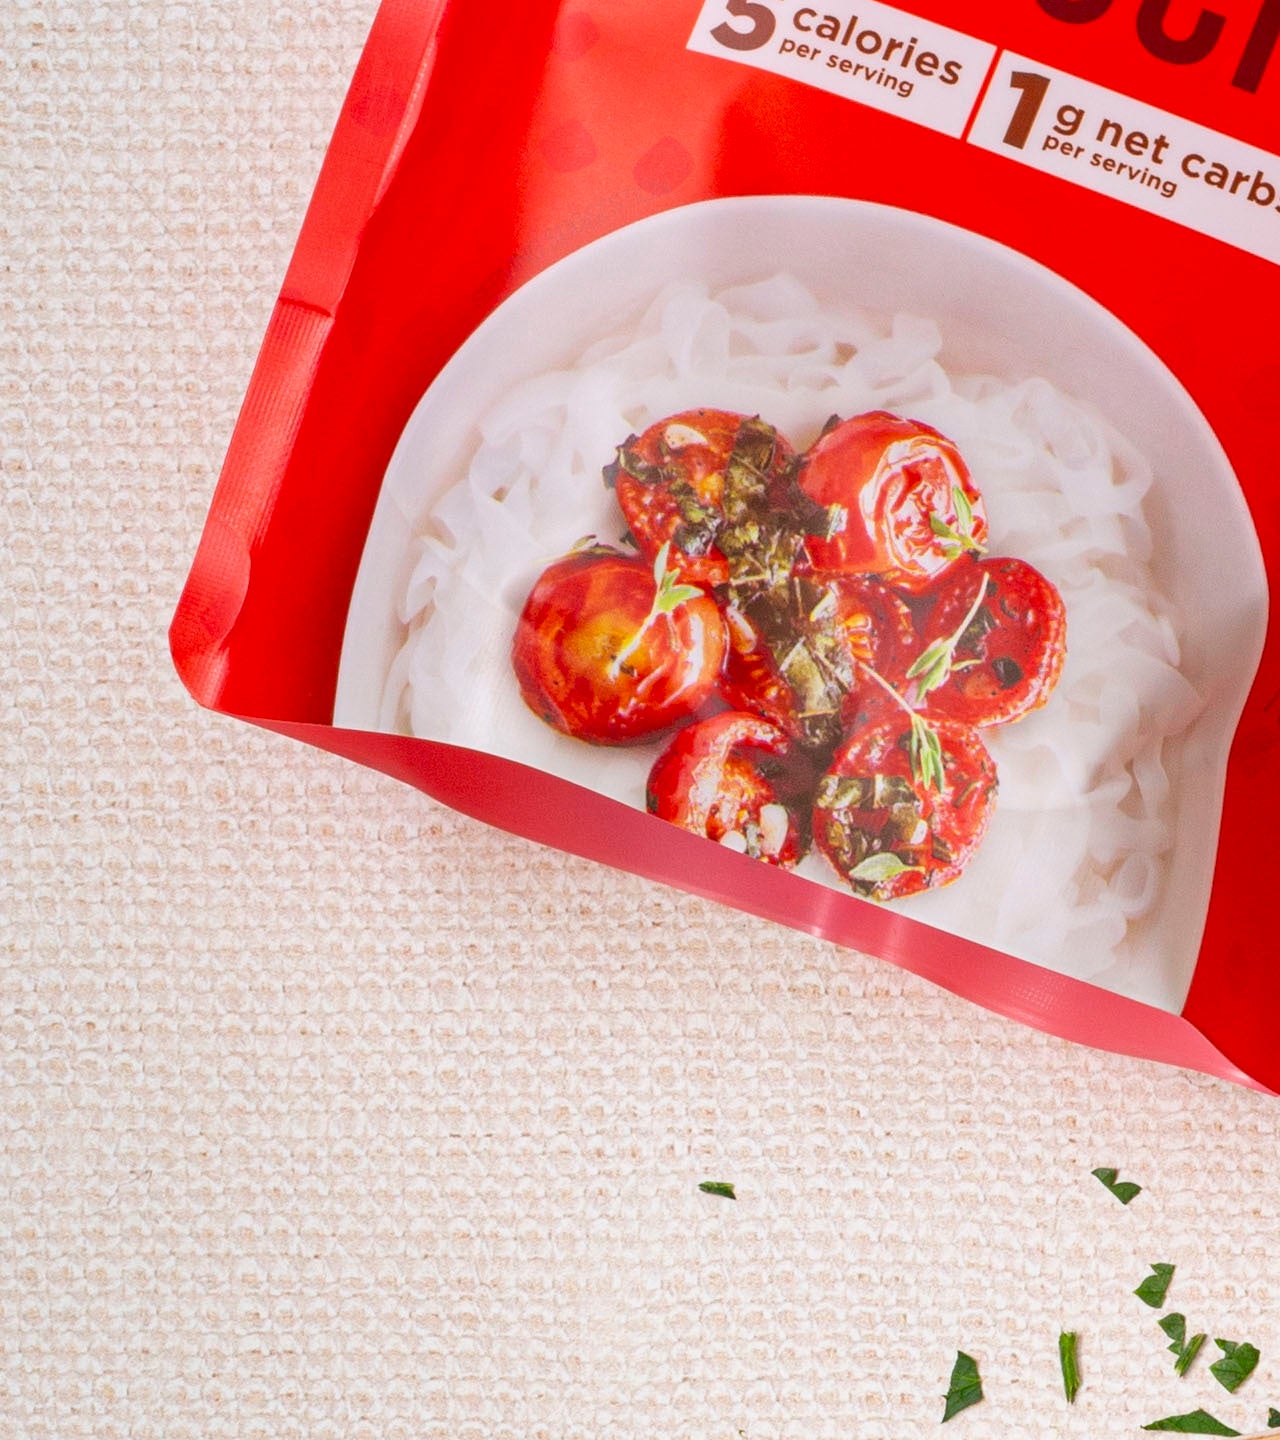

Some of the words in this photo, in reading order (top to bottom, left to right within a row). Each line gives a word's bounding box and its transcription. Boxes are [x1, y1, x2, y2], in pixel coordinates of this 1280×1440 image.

[778, 37, 821, 62] per
[826, 52, 915, 98] serving
[792, 7, 963, 86] calories
[1041, 135, 1085, 159] per
[1090, 152, 1178, 199] serving
[1096, 118, 1170, 164] net
